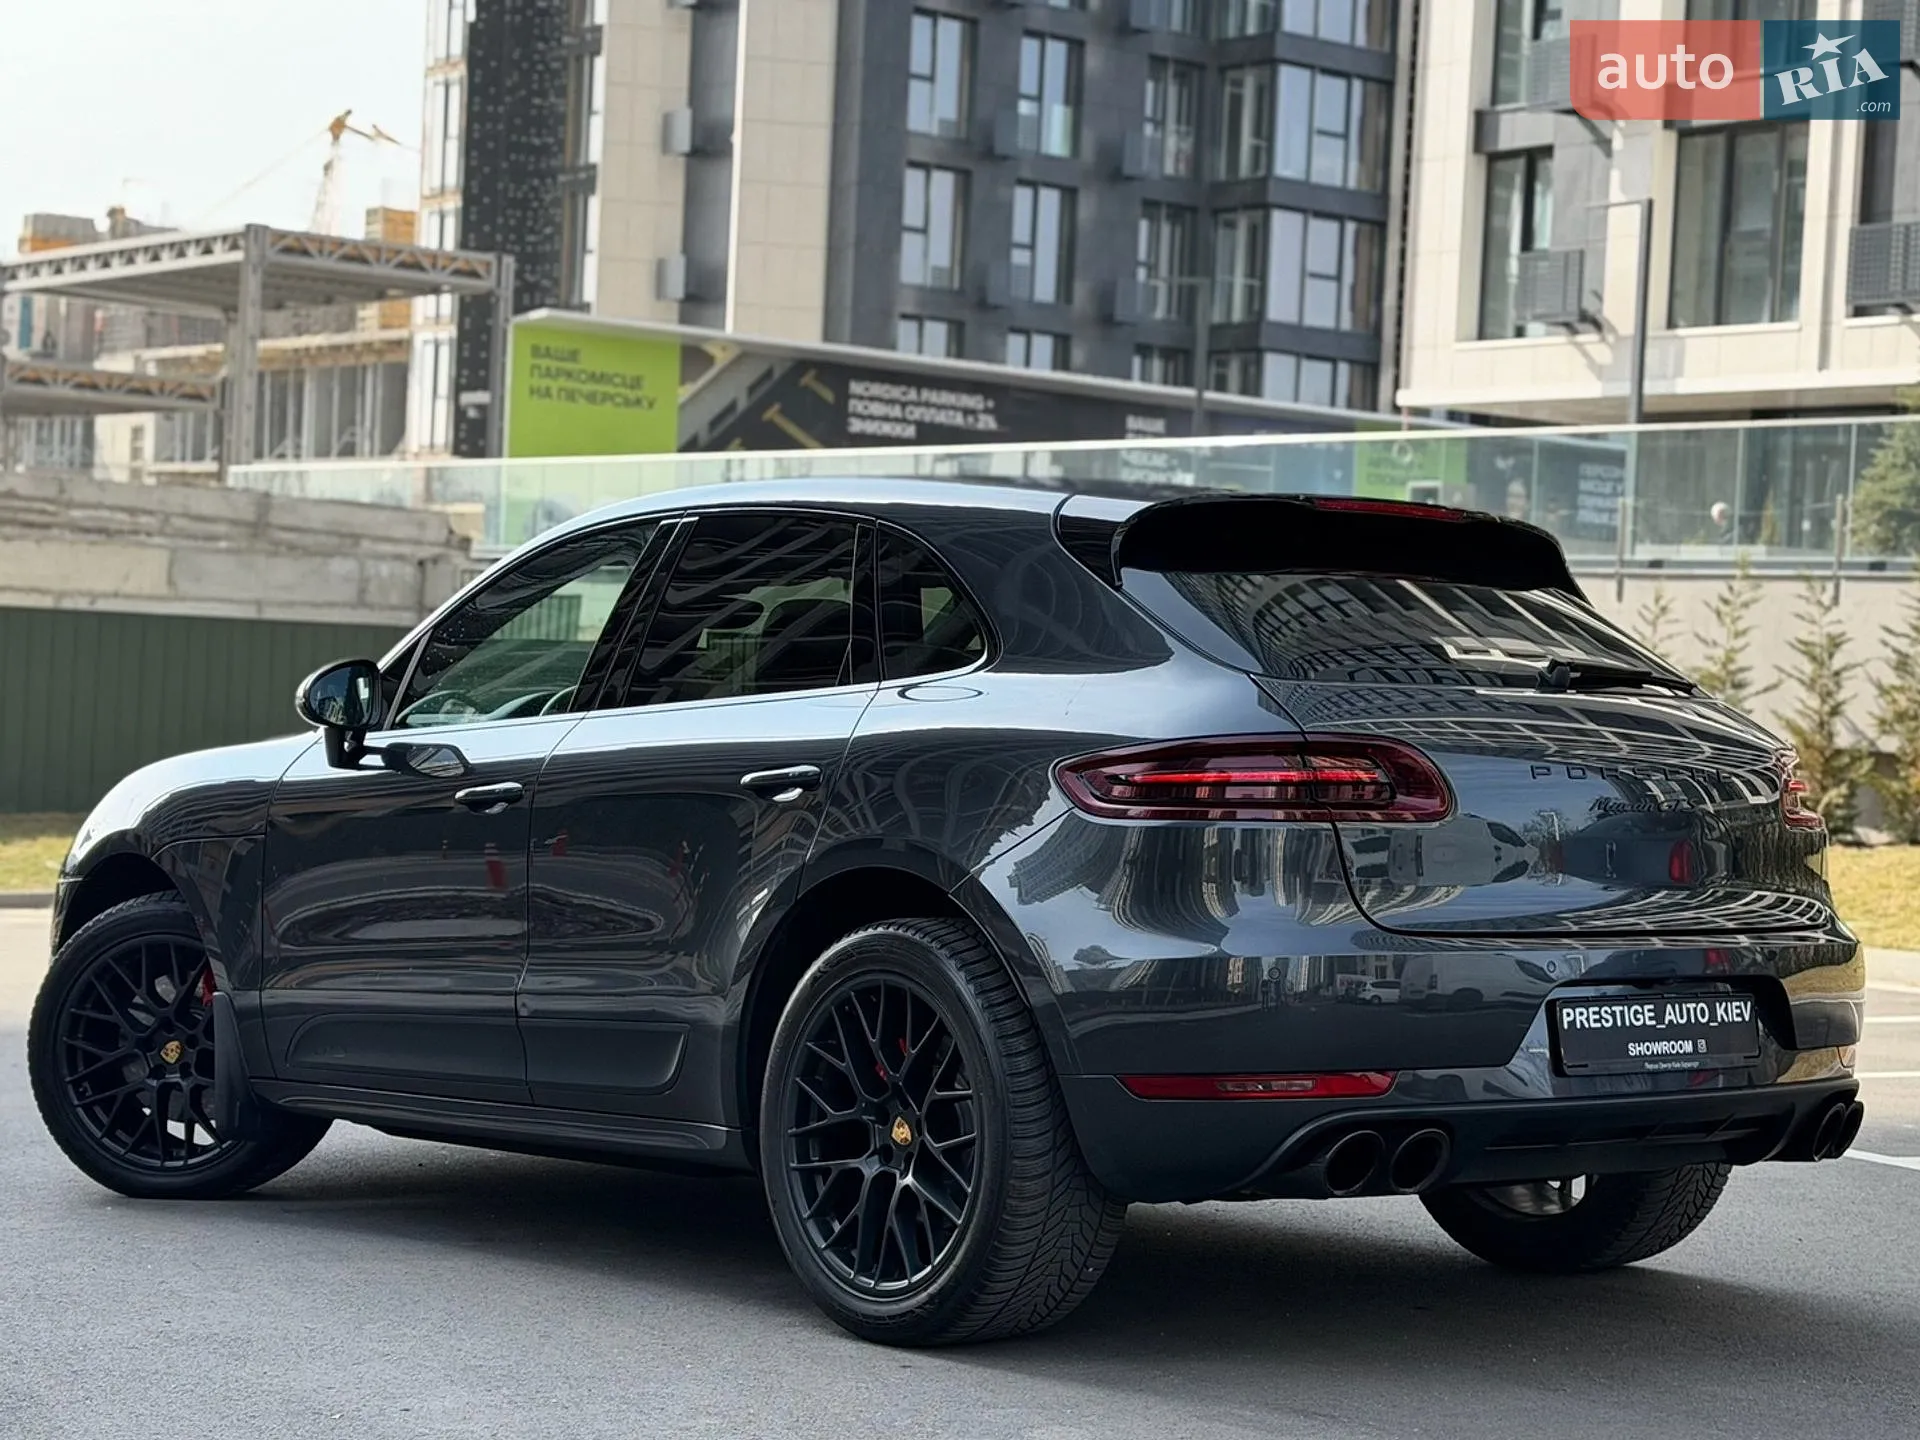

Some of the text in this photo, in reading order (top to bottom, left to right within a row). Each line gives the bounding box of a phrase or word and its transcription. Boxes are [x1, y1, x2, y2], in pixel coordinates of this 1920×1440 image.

[530, 344, 581, 364] ВАШЕ
[530, 363, 644, 391] ПАРКОМІСЦЕ
[529, 385, 657, 410] НА ПЕЧЕРСЬКУ
[920, 387, 985, 411] PARKING
[848, 398, 903, 419] ПОВНА
[904, 404, 965, 427] ОПЛАТА
[1562, 1001, 1752, 1029] PRESTIGE_AUTO_KIEV
[1628, 1040, 1693, 1056] SHOWROOM
